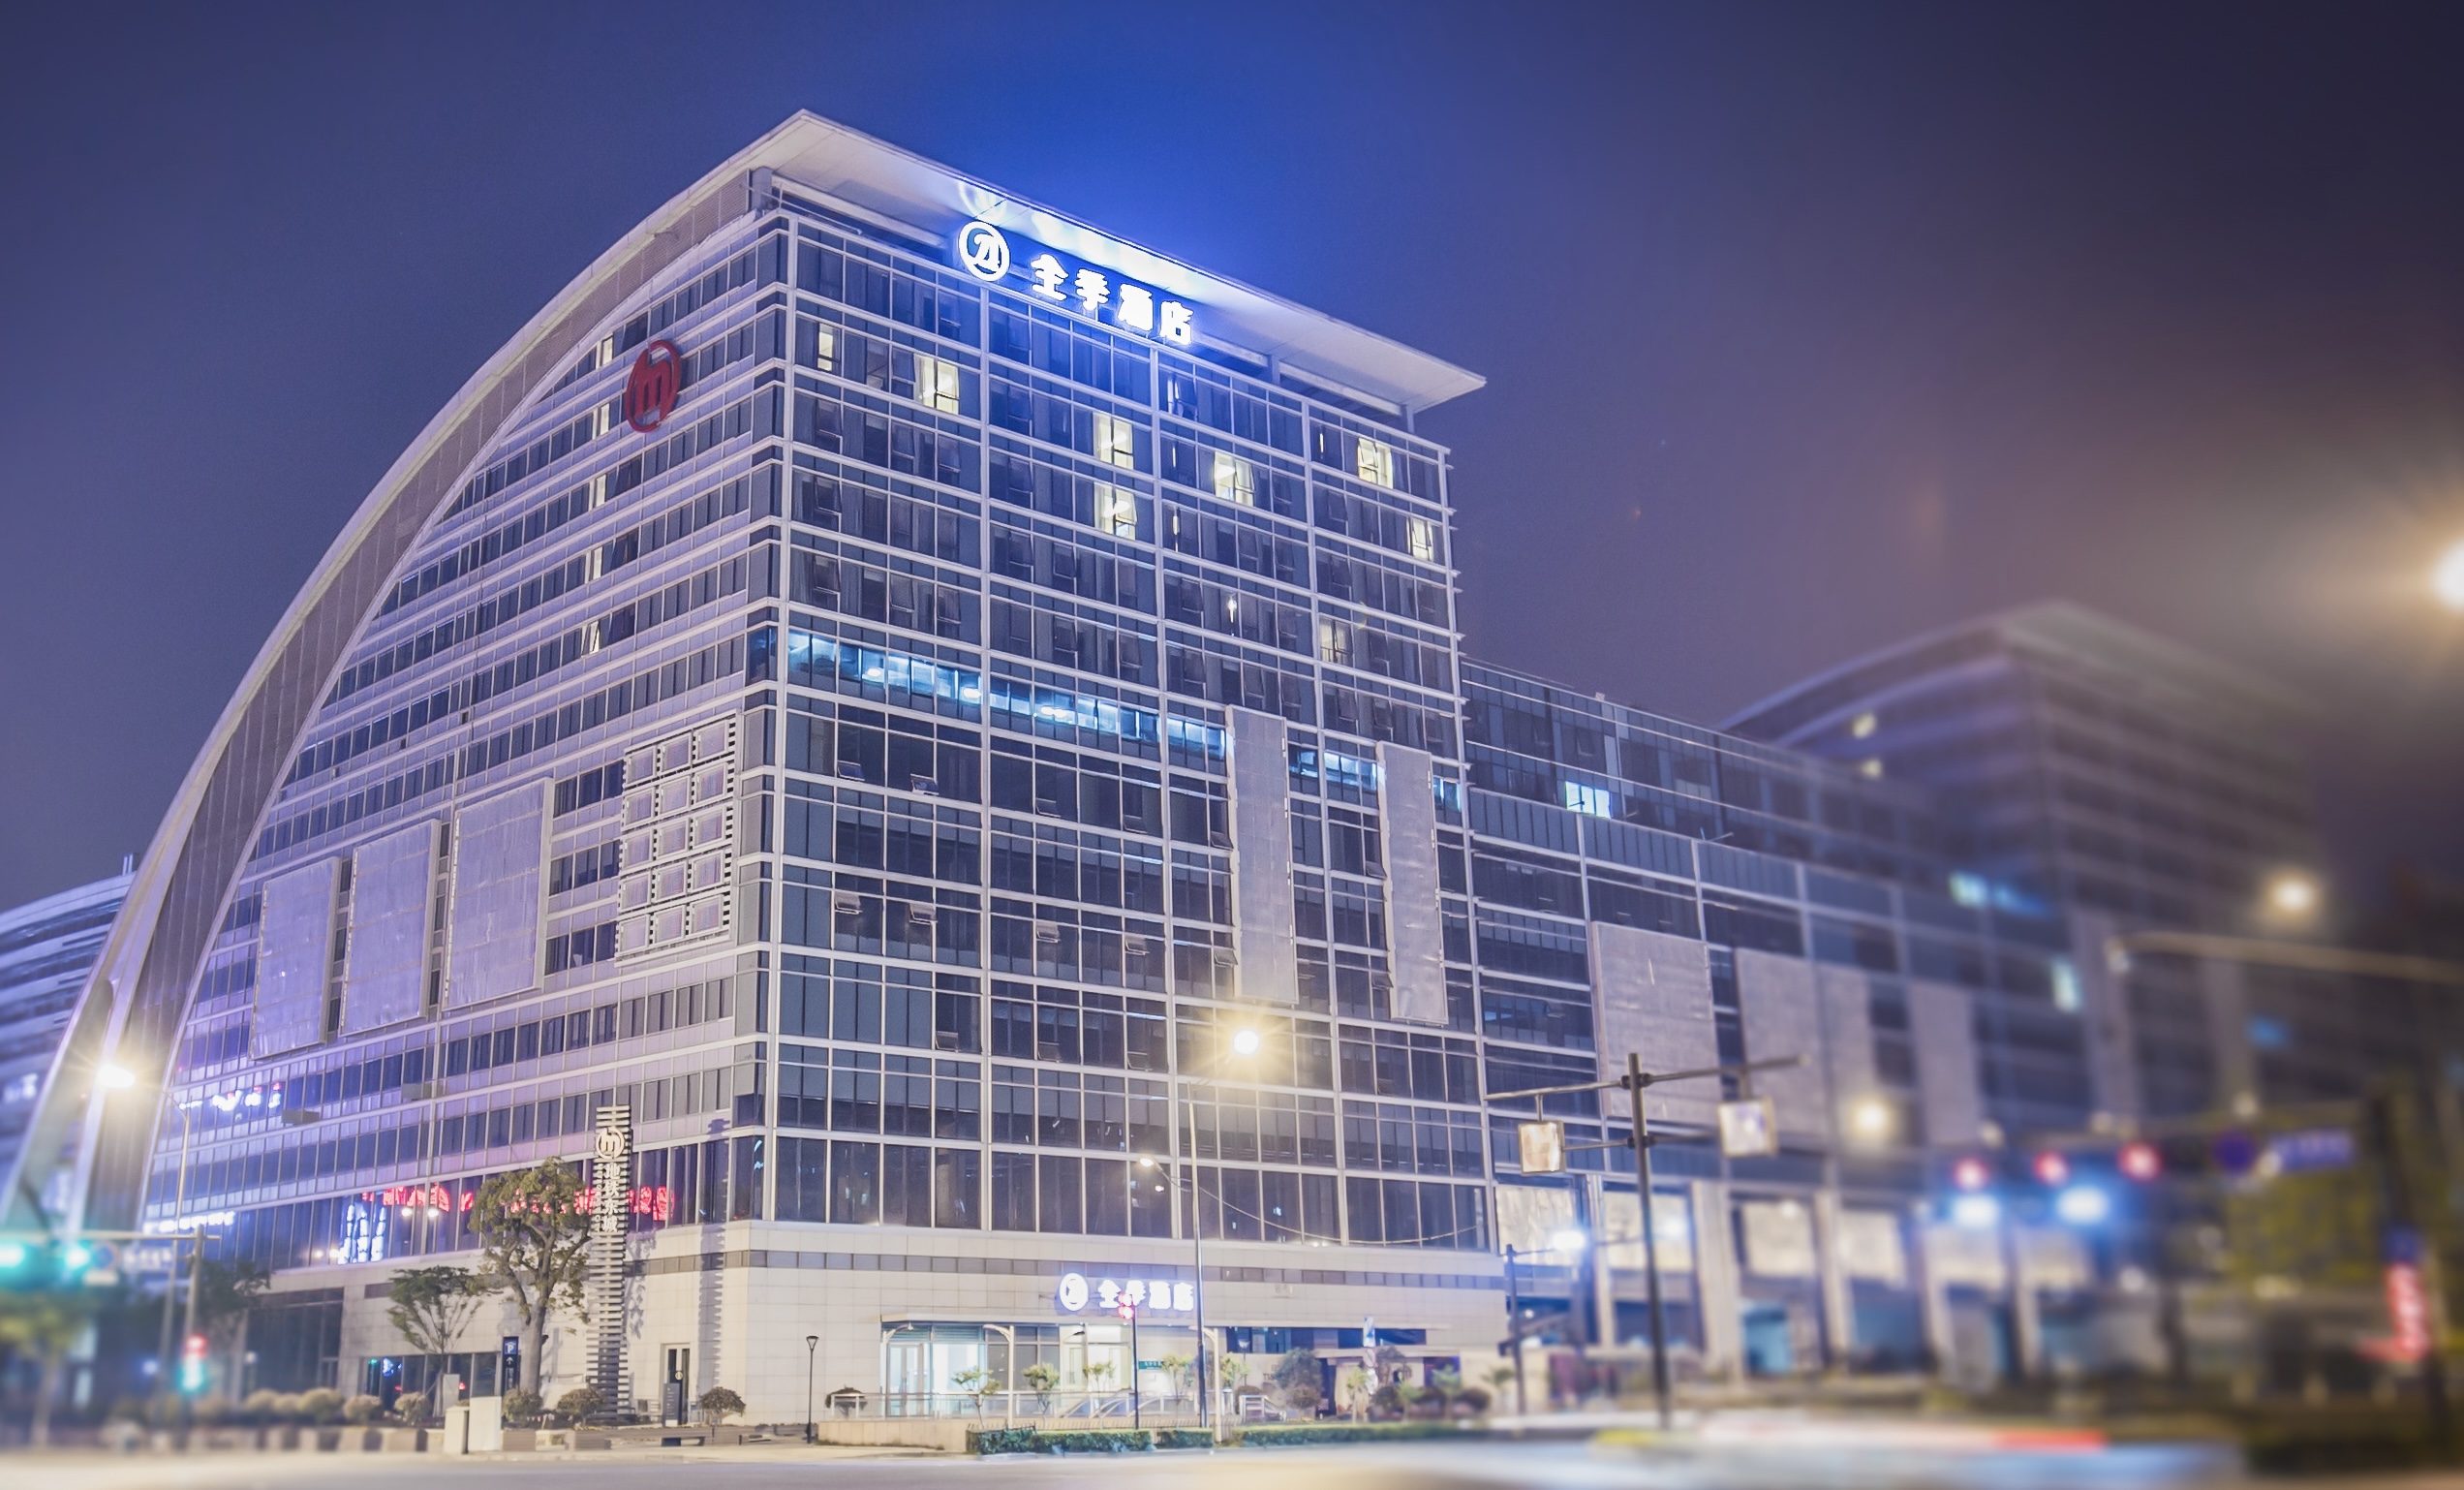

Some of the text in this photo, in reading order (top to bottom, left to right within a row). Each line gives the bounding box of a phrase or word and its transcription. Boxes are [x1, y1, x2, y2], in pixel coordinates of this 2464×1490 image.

[1030, 253, 1193, 345] 全季酒店
[602, 1163, 621, 1232] 地铁东城
